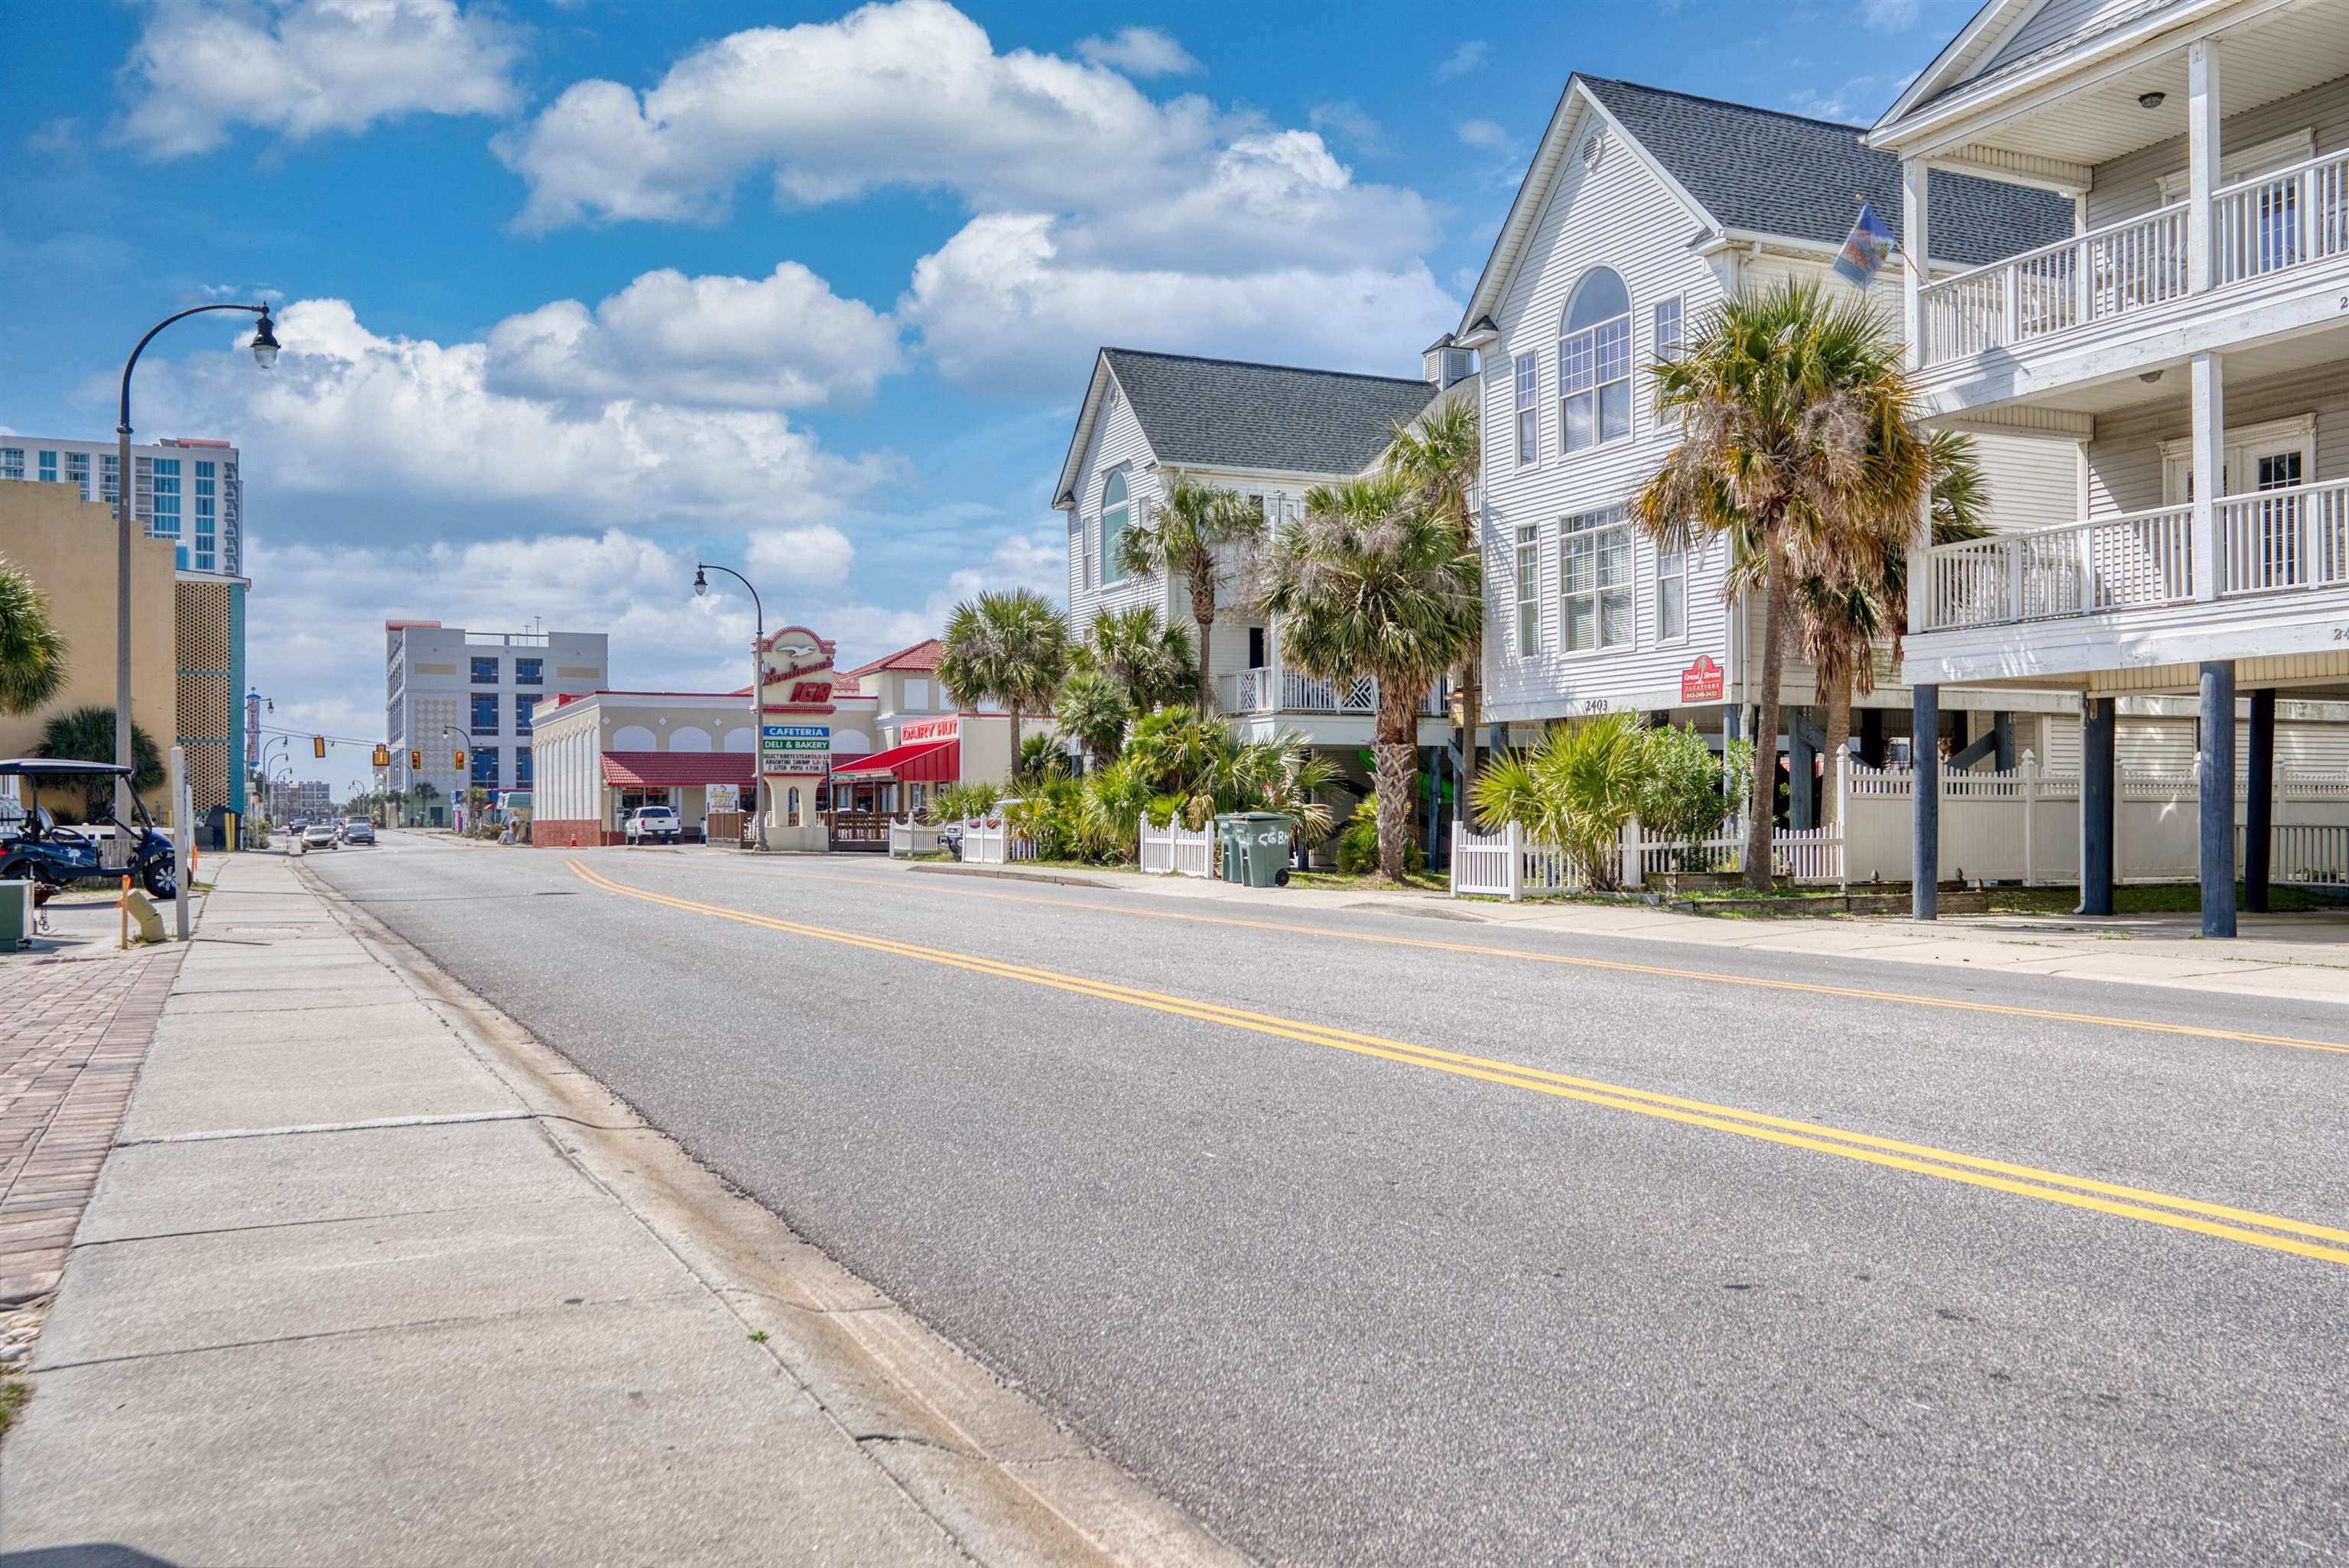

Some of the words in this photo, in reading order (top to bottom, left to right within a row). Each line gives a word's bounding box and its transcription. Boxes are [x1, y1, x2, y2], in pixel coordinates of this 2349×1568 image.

[1684, 672, 1700, 680] Grand
[1704, 669, 1721, 678] Strand
[789, 682, 832, 703] IGA
[1585, 699, 1608, 711] 2403
[902, 722, 935, 741] DAIRY
[937, 721, 957, 736] HUT
